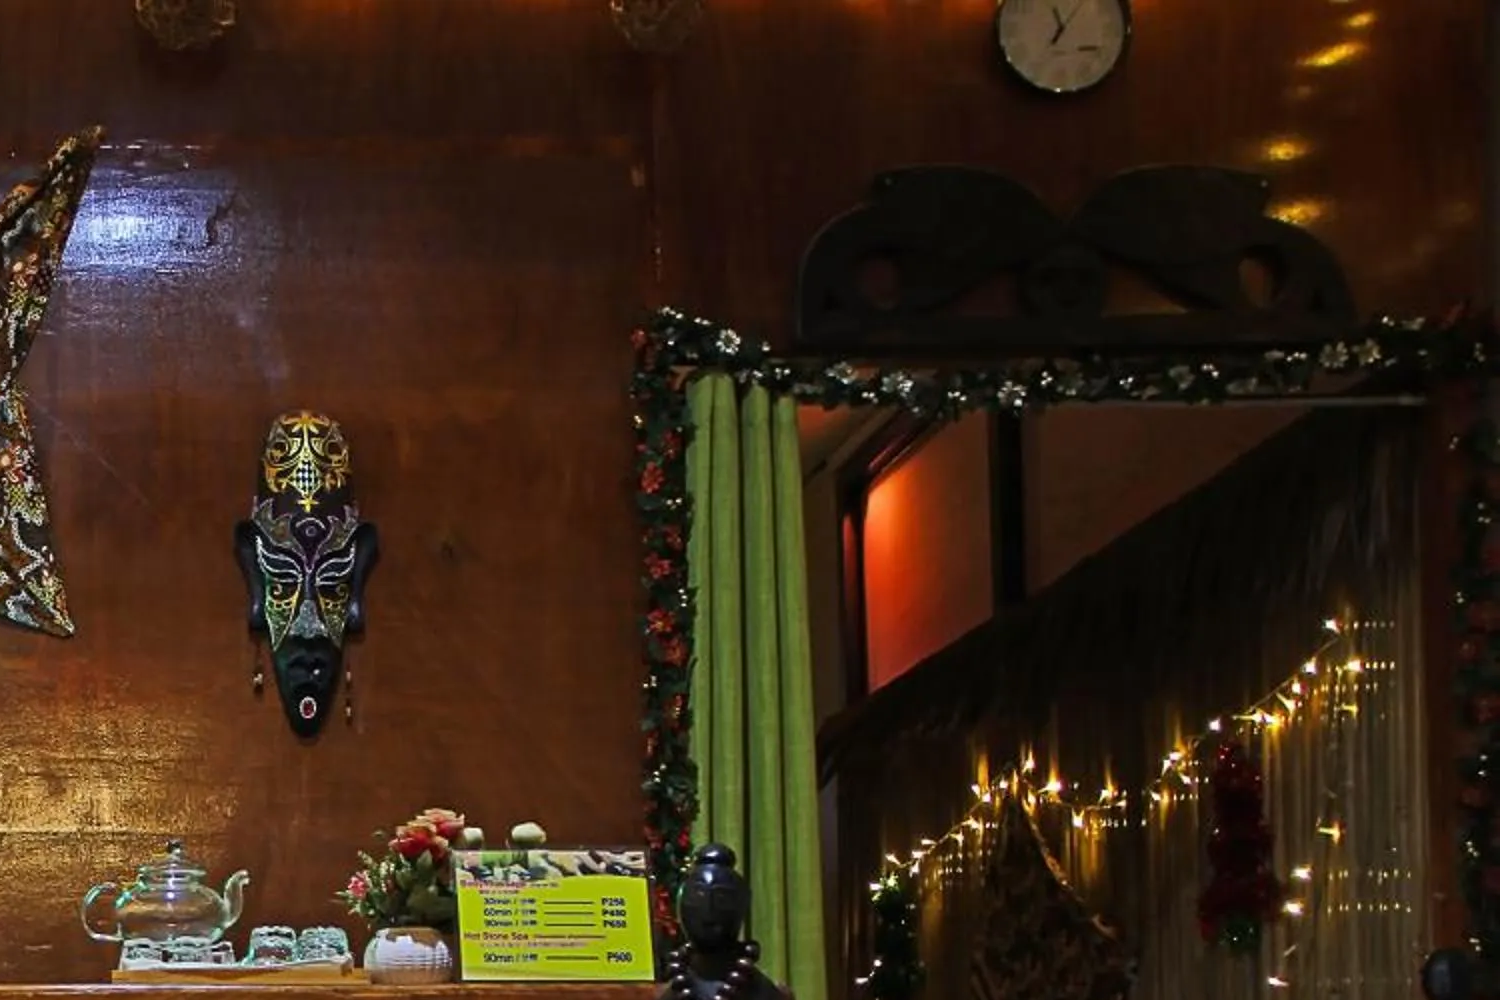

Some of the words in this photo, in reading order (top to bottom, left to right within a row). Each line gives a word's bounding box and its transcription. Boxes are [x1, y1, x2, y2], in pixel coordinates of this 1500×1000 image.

[484, 907, 512, 916] 60min
[483, 931, 509, 940] Stone
[511, 931, 529, 941] Spa
